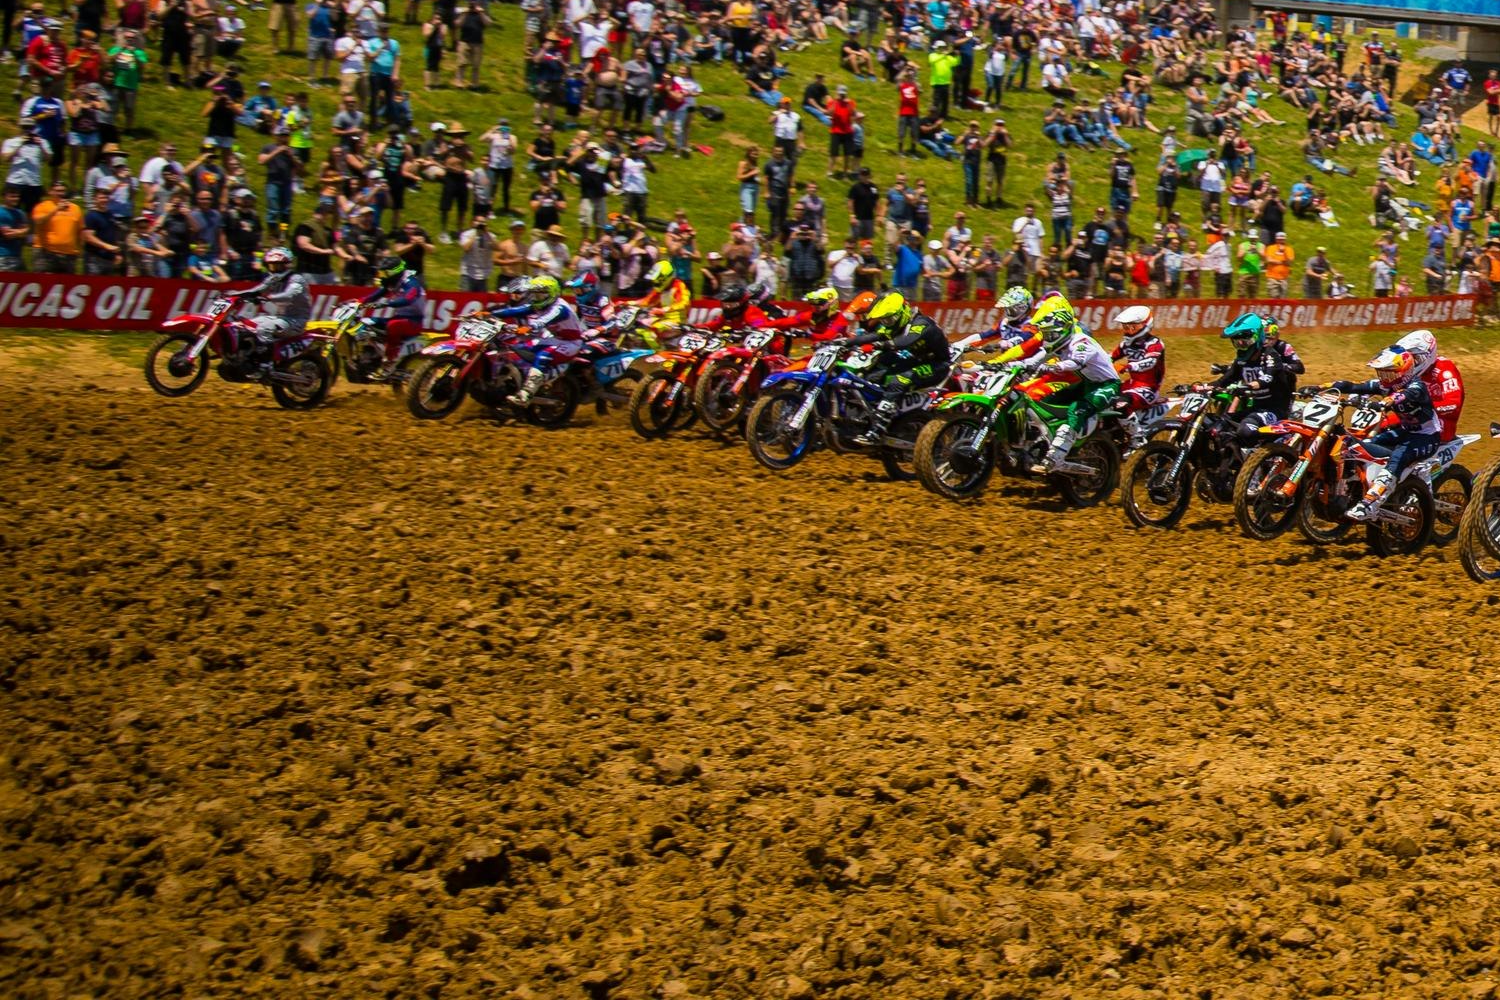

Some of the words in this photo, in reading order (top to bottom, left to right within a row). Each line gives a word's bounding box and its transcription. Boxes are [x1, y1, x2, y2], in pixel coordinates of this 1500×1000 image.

[94, 285, 154, 320] OIL
[1203, 305, 1230, 329] OIL
[1293, 304, 1319, 327] OIL
[1324, 303, 1375, 327] LUCAS
[1375, 303, 1399, 324] OIL
[1403, 301, 1452, 323] LUCAS
[1452, 299, 1474, 320] OIL
[1138, 404, 1165, 423] 270
[1304, 403, 1331, 423] 2
[1352, 411, 1378, 430] 29
[1437, 448, 1453, 465] 29
